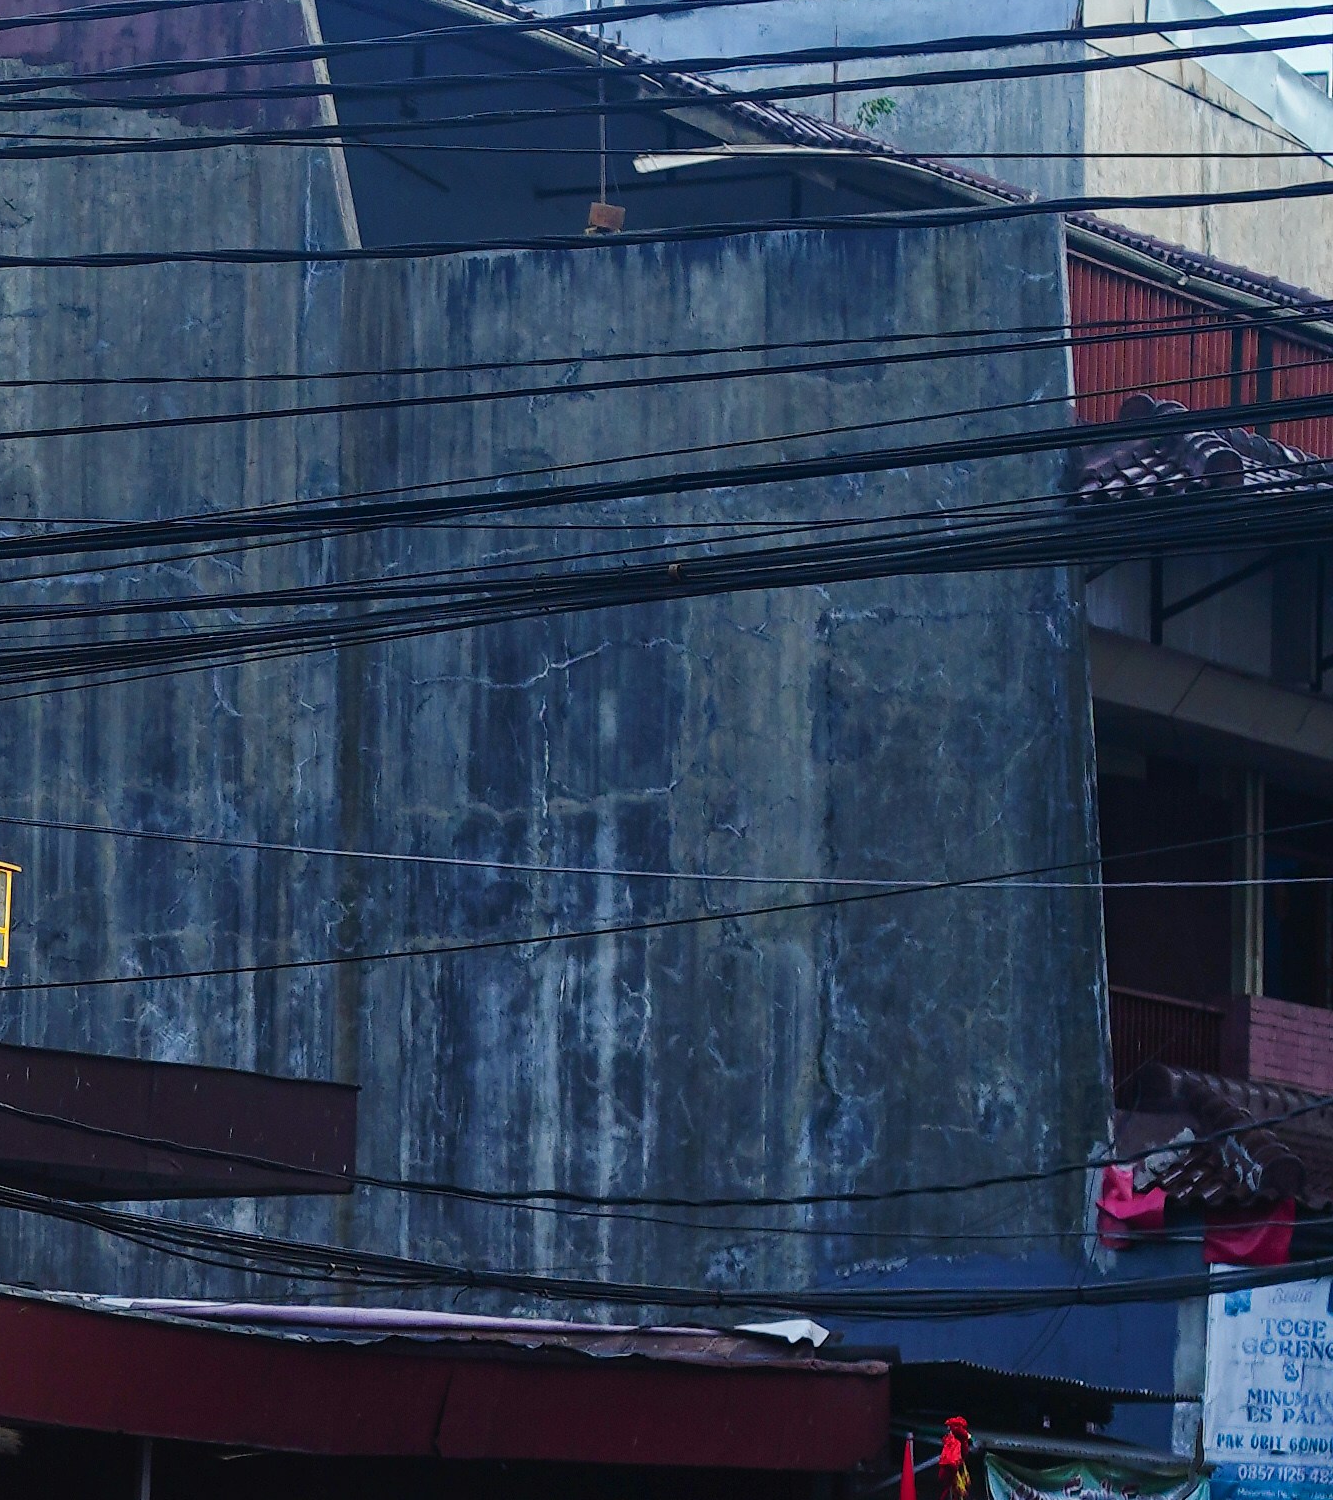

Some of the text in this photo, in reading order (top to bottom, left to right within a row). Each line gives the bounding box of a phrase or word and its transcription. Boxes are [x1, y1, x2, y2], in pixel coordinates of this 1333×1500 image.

[1261, 1317, 1327, 1339] TOGE
[1247, 1404, 1273, 1424] ES
[1217, 1432, 1244, 1450] PAK
[1238, 1463, 1275, 1482] 0857
